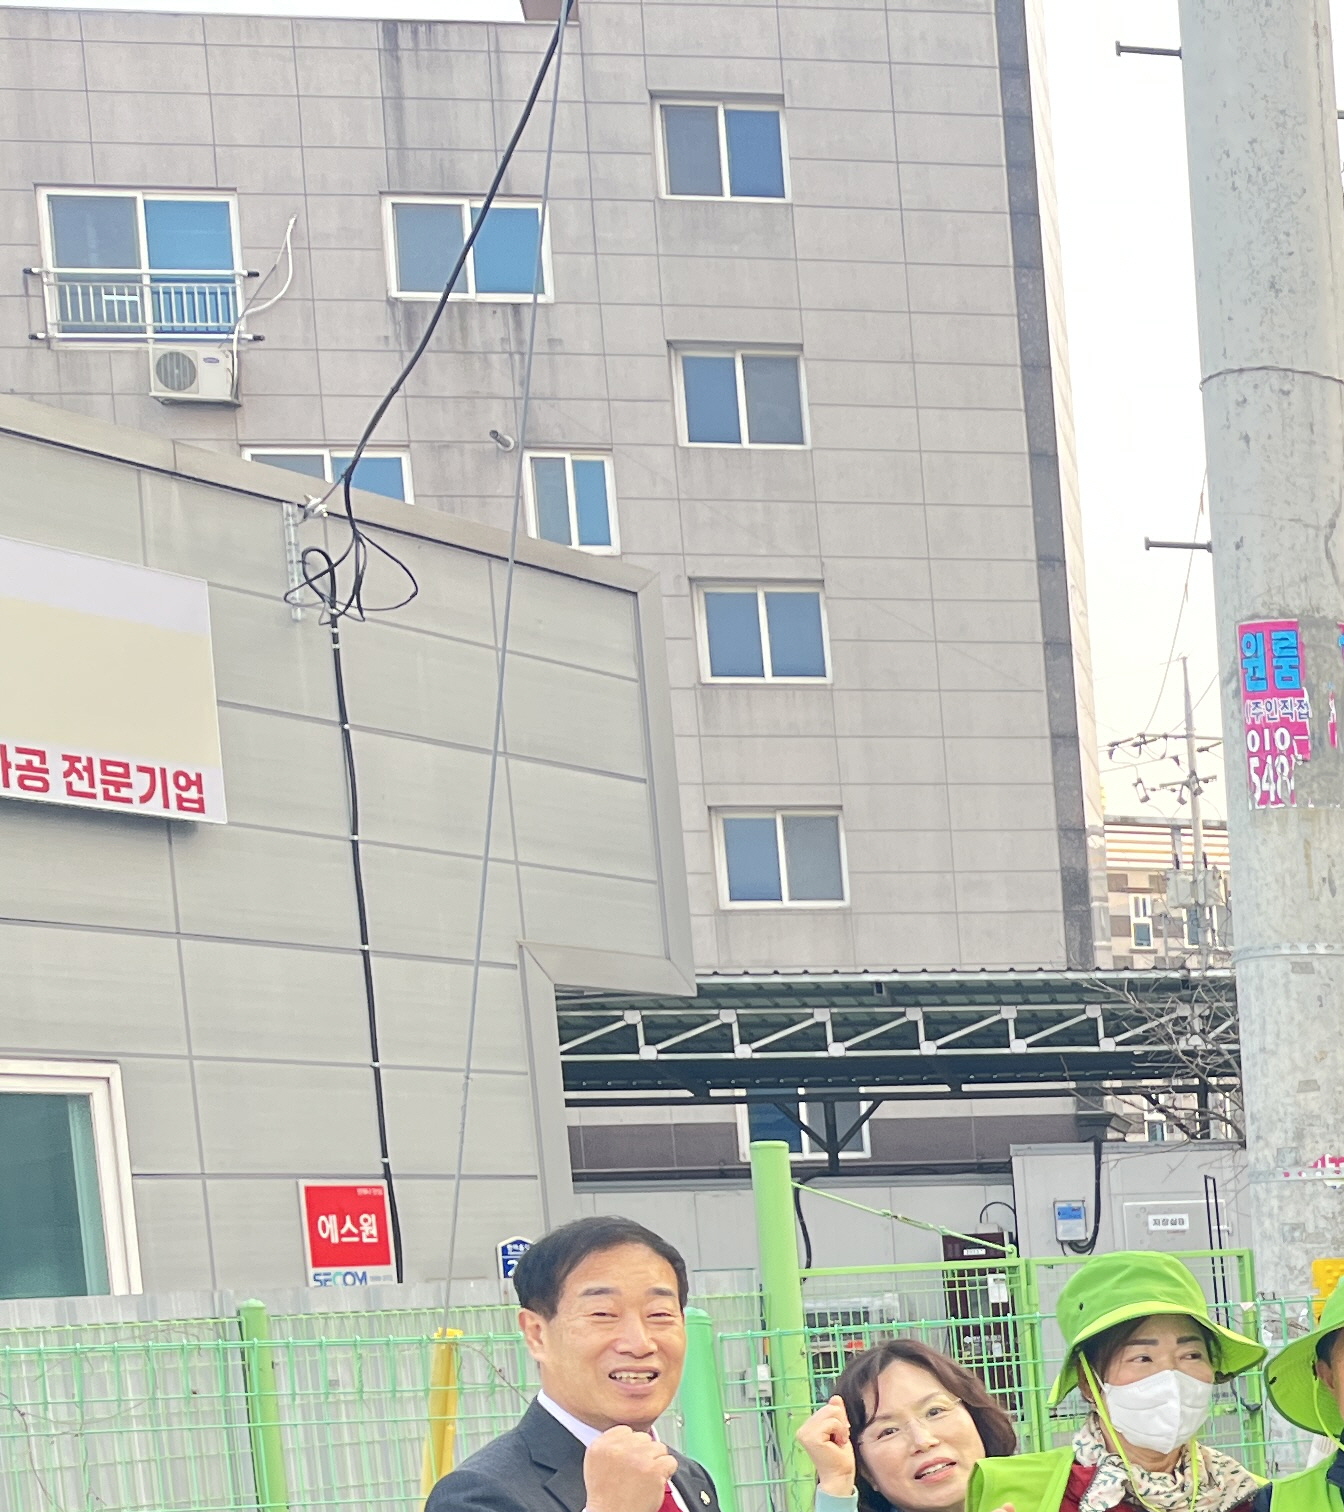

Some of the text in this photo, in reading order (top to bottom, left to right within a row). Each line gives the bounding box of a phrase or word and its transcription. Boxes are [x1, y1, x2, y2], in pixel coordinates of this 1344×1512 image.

[1241, 630, 1302, 692] 원룸
[61, 753, 206, 814] 전문기업
[317, 1213, 379, 1244] 에스원
[313, 1270, 368, 1288] SECOM
